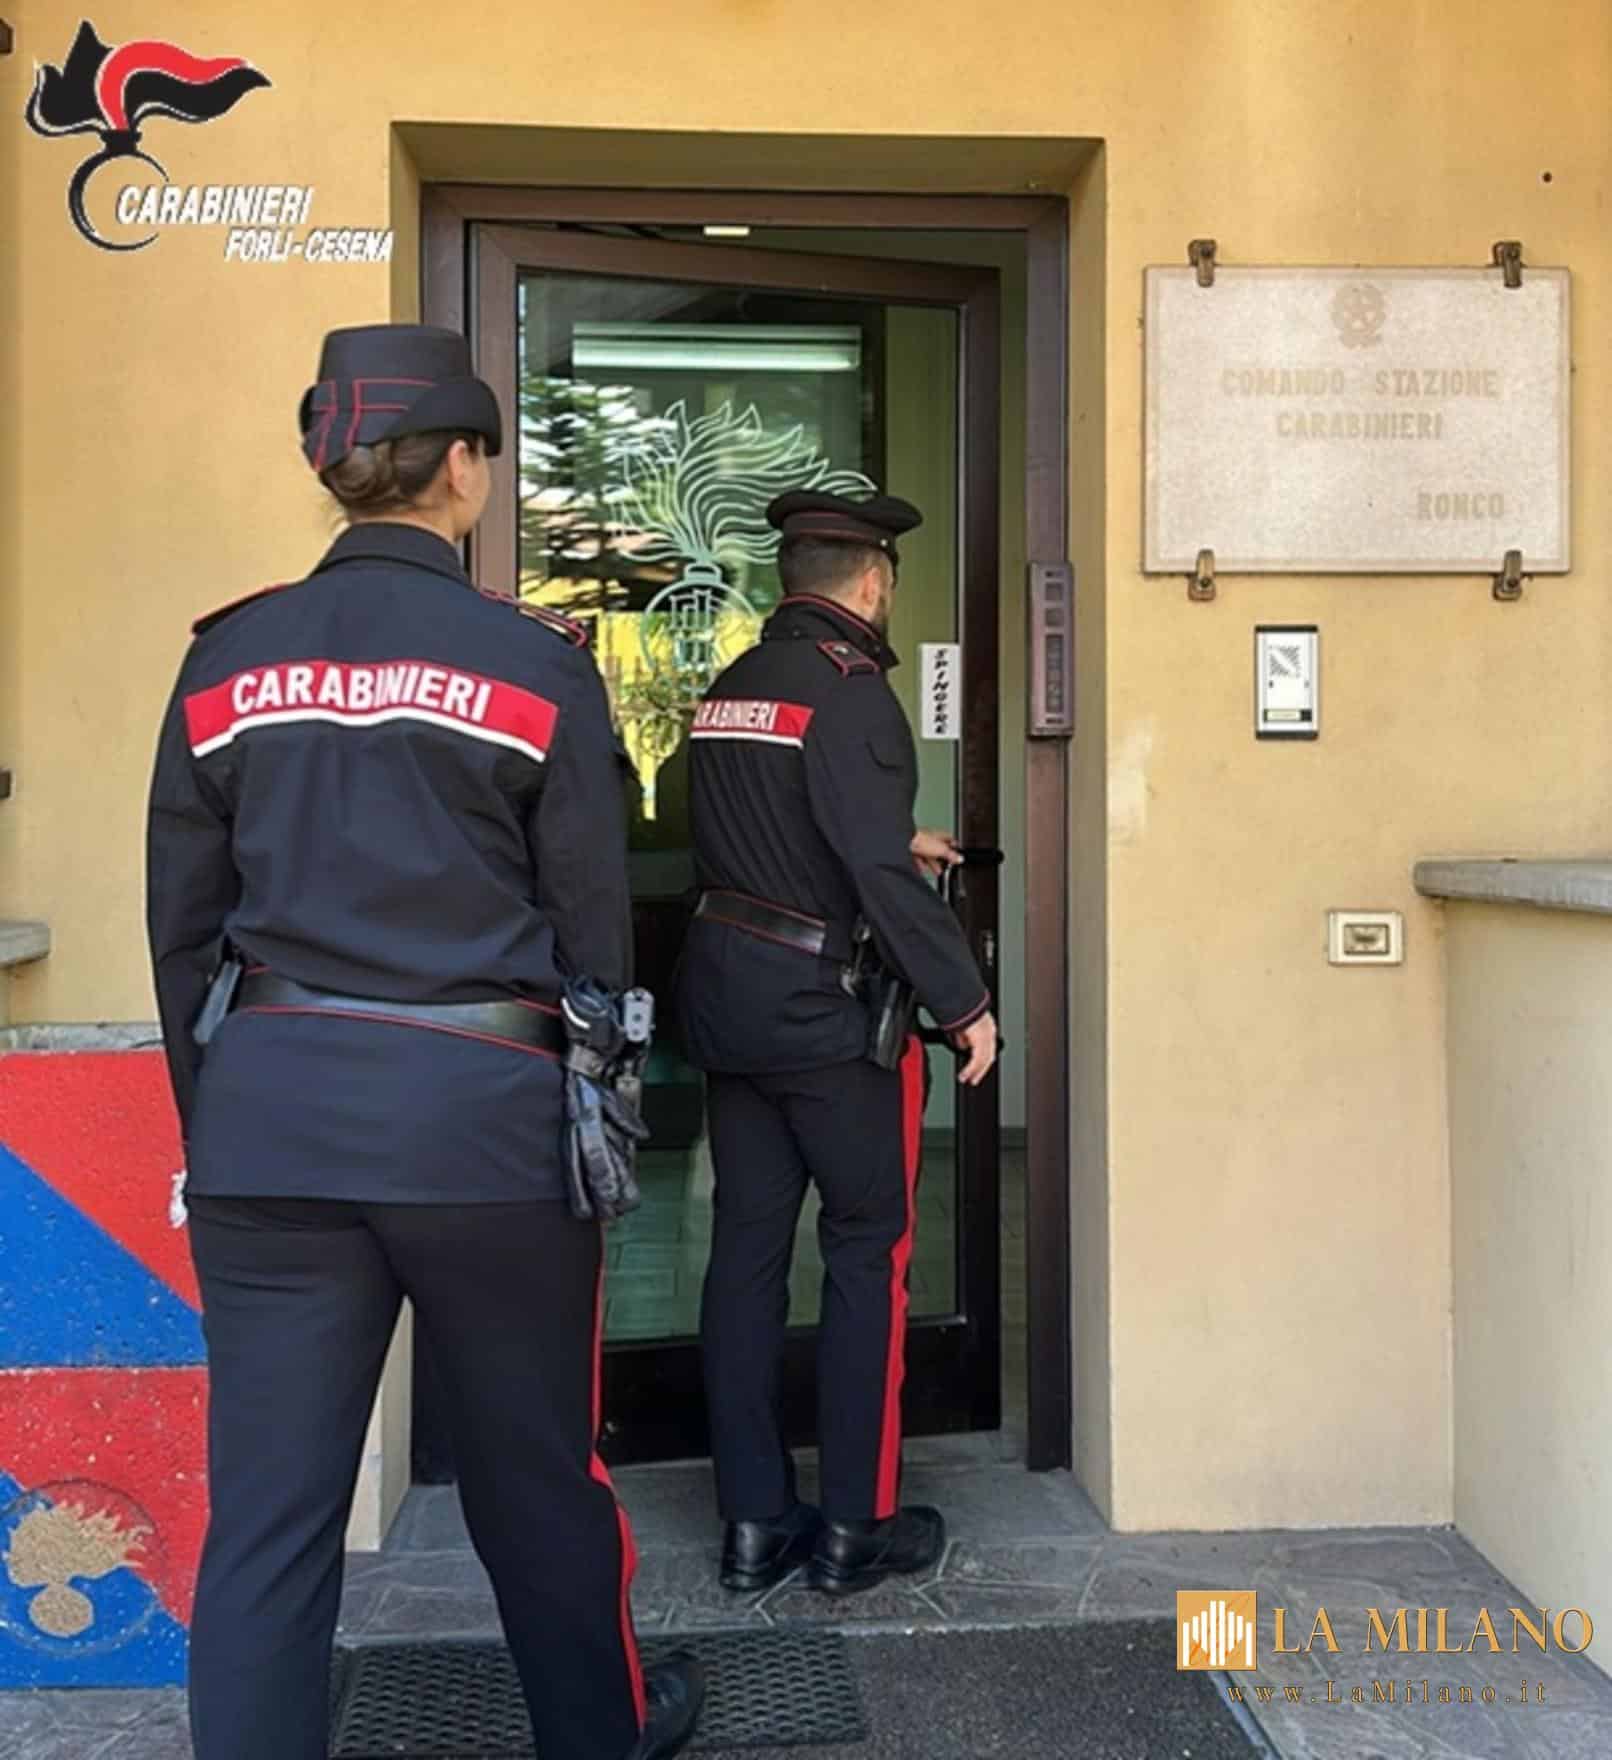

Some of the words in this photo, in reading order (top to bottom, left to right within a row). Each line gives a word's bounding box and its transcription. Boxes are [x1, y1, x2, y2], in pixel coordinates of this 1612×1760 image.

[1220, 367, 1345, 398] COMANDO
[1374, 368, 1500, 398] STAZIONE
[1275, 411, 1445, 441] CARABINIERI
[1416, 491, 1505, 521] RONCO
[231, 664, 492, 723] CARABINIERI
